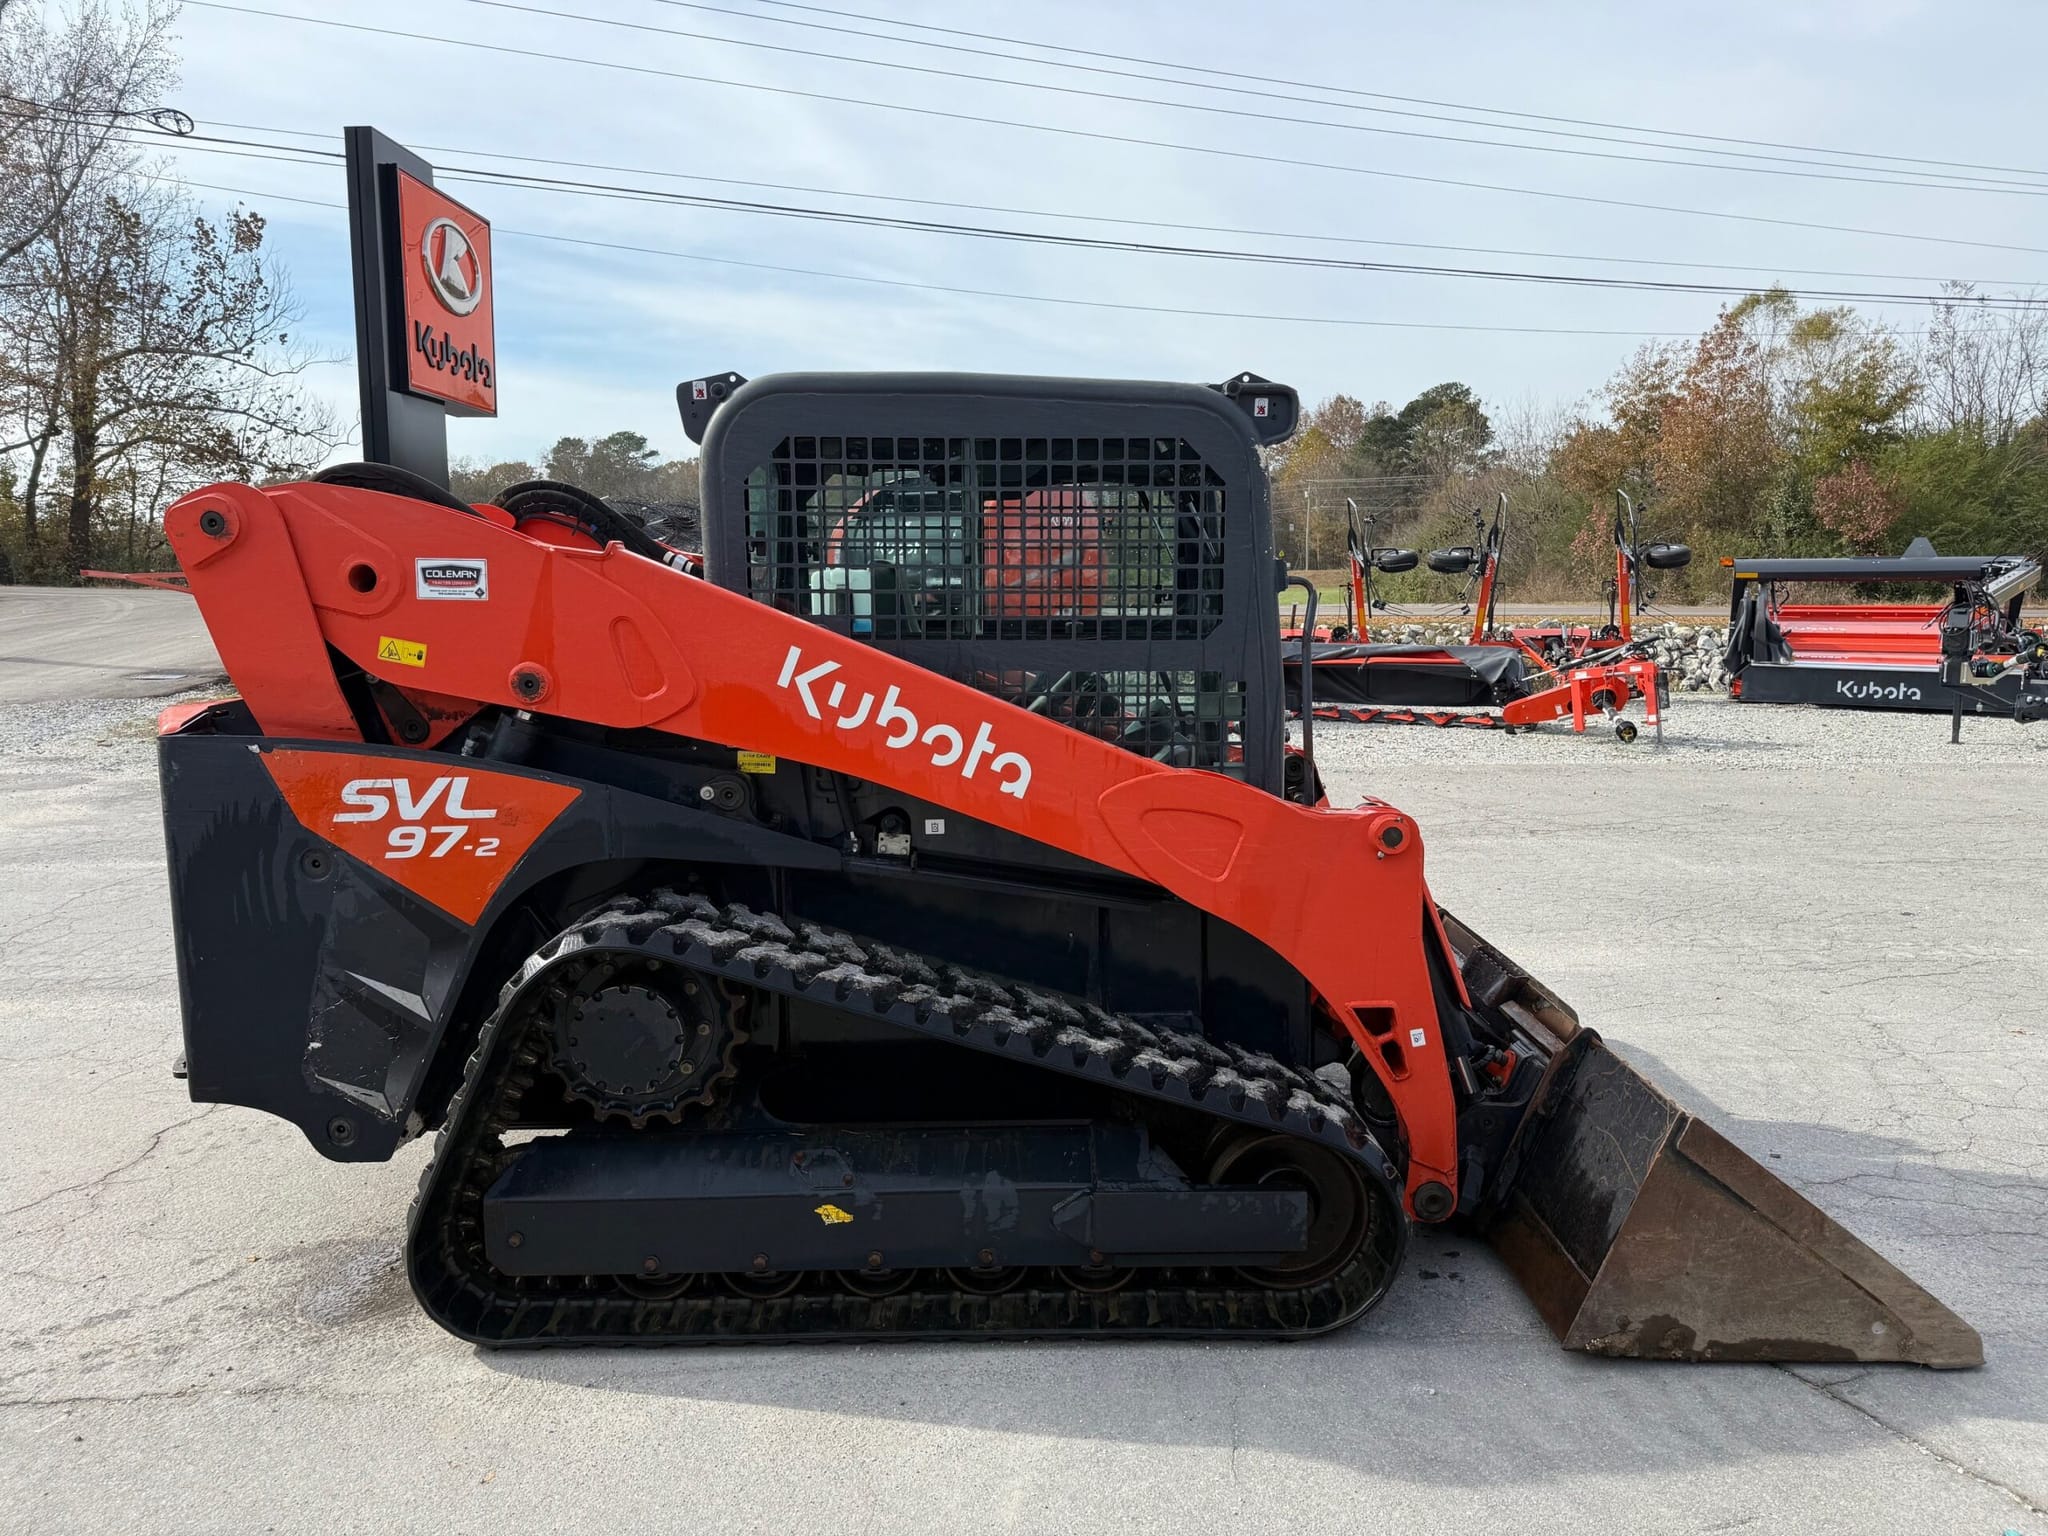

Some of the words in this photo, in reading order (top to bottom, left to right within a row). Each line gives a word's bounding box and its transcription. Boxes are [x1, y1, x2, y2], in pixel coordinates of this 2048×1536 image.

[415, 320, 491, 388] Kubota
[425, 569, 478, 579] COLEMAN
[1836, 680, 1921, 701] Kubota
[776, 645, 1032, 800] Kubota
[333, 776, 498, 823] SVL
[384, 825, 501, 859] 97-2
